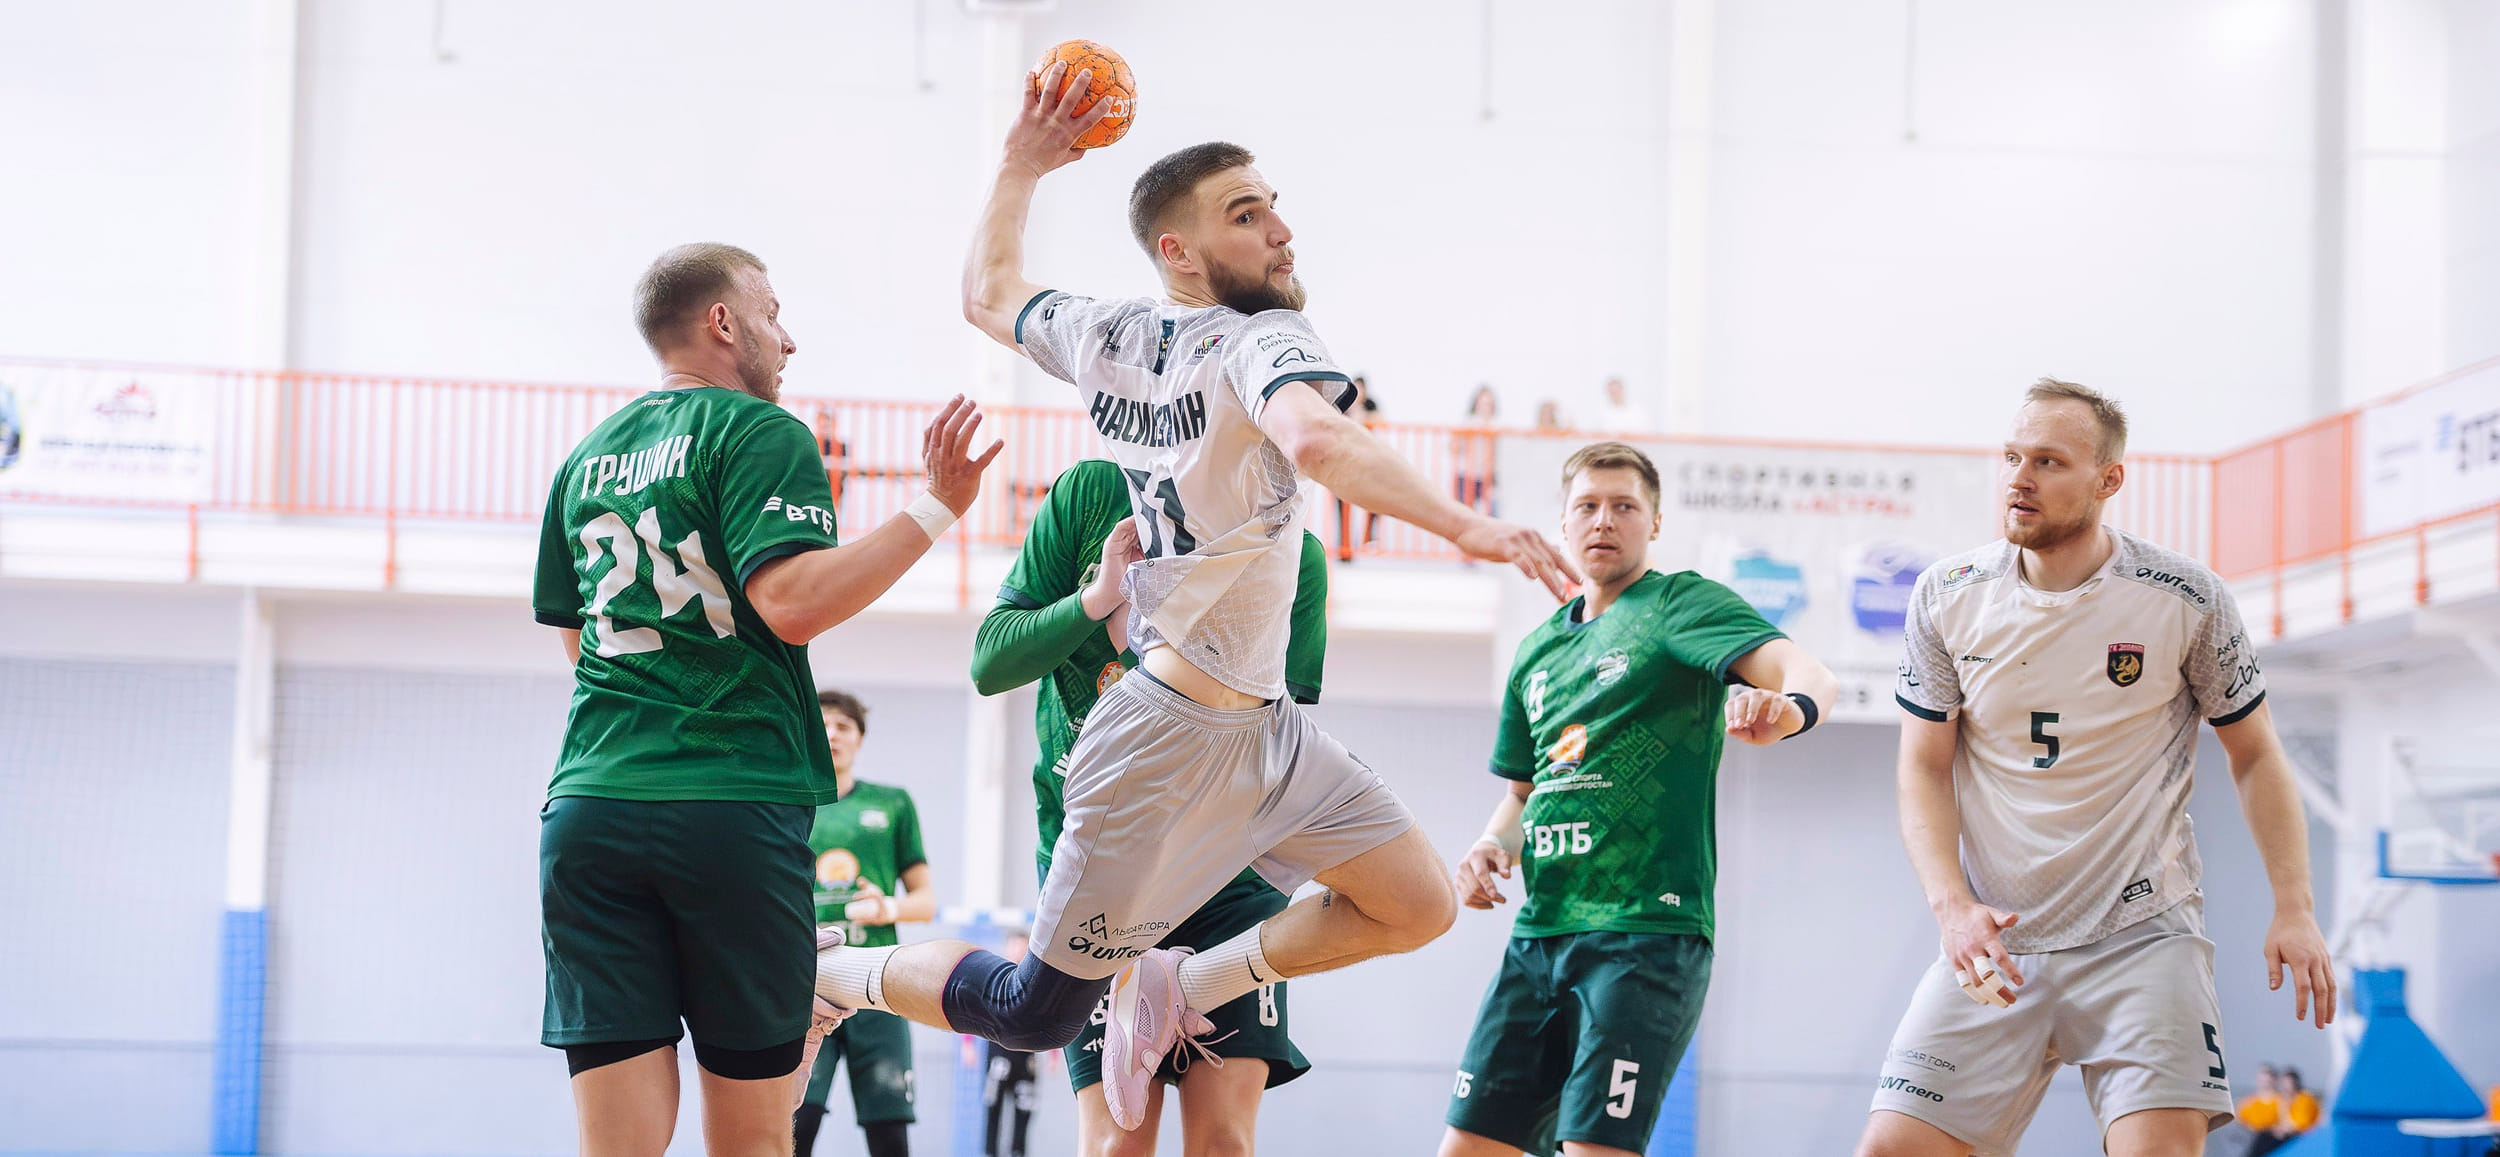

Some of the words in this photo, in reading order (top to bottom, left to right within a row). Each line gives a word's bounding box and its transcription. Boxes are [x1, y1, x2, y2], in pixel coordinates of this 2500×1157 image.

[580, 434, 693, 500] ТРУШИН
[786, 503, 834, 536] ВТБ
[579, 506, 737, 659] 24
[2153, 571, 2186, 587] UVT
[2180, 583, 2206, 604] aero
[1528, 669, 1548, 723] 5
[2031, 711, 2060, 769] 5
[1534, 821, 1593, 858] ВТБ
[1928, 1056, 1956, 1072] ГОРА
[2202, 1022, 2227, 1079] 5
[1453, 1069, 1475, 1099] ТБ
[1606, 1058, 1640, 1119] 5
[1905, 1085, 1944, 1102] aero
